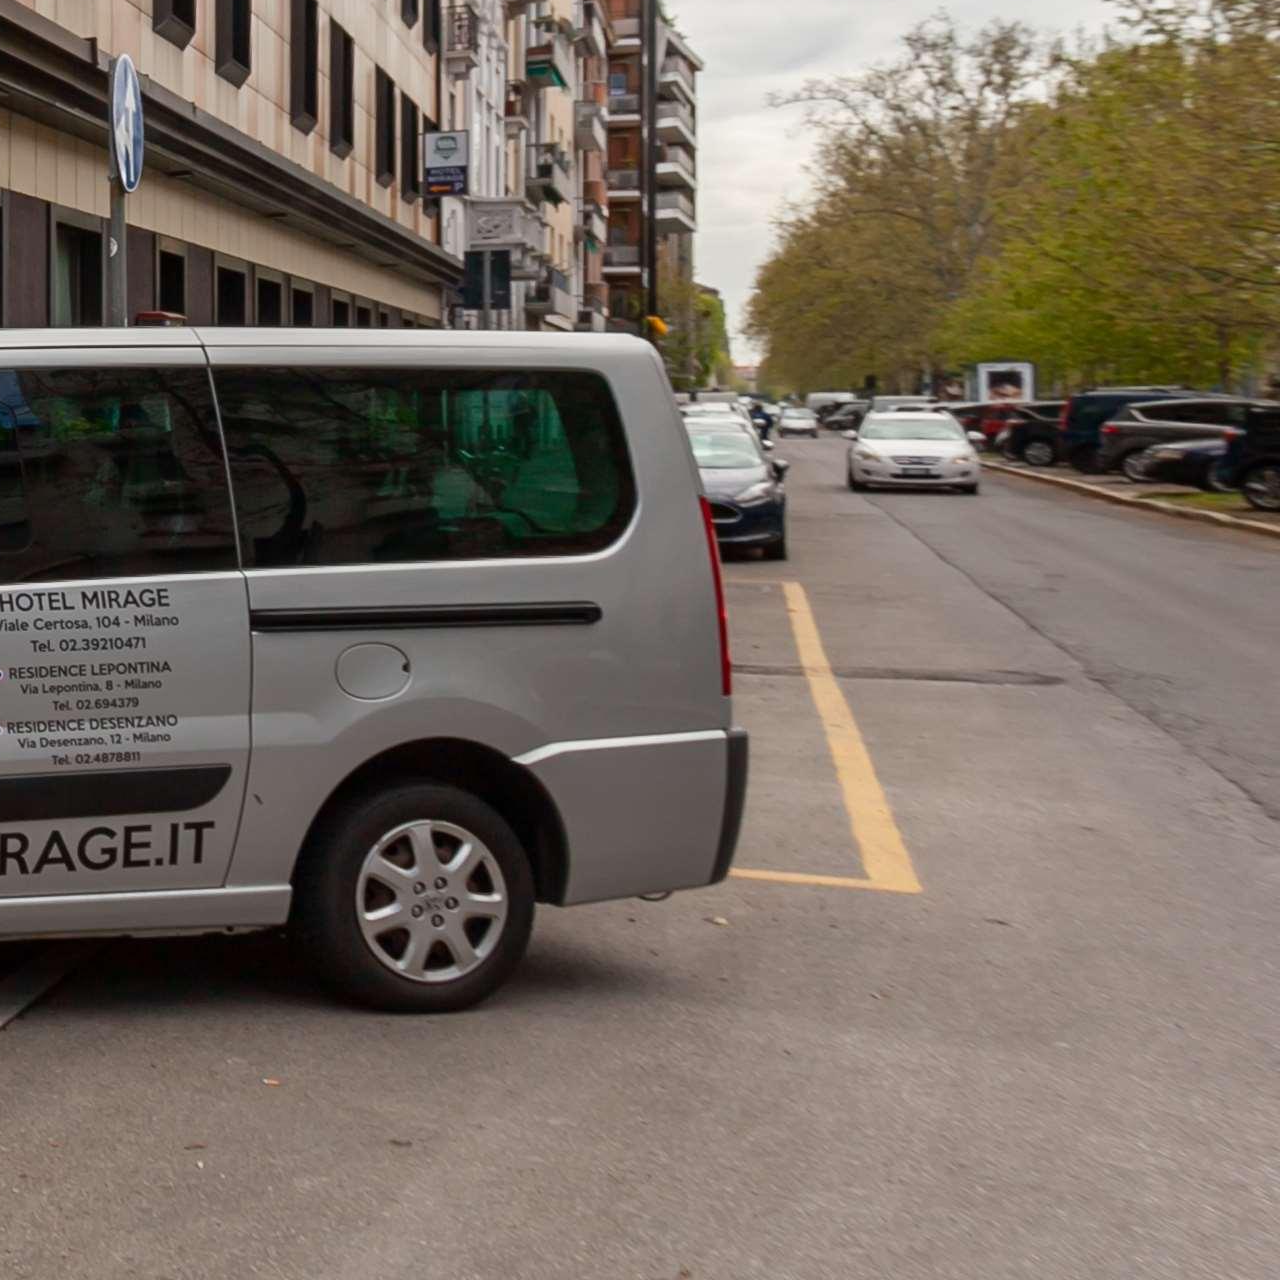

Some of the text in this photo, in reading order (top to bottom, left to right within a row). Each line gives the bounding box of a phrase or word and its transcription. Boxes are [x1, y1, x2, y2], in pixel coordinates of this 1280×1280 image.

[80, 588, 170, 610] MIRAGE
[33, 617, 92, 631] Certosa,
[96, 616, 121, 629] 104
[134, 613, 179, 627] Milano
[59, 637, 147, 651] 02.39210471
[8, 661, 172, 680] RESIDENCE LEPONTINA
[20, 683, 39, 695] Via
[105, 680, 113, 691] 8
[125, 677, 162, 690] Milano
[76, 697, 139, 711] 02.694379
[7, 714, 179, 734] RESIDENCE DESENZANO
[17, 738, 37, 749] Via
[110, 734, 122, 745] 12
[133, 731, 171, 744] Milano
[75, 751, 141, 765] 02.4878811
